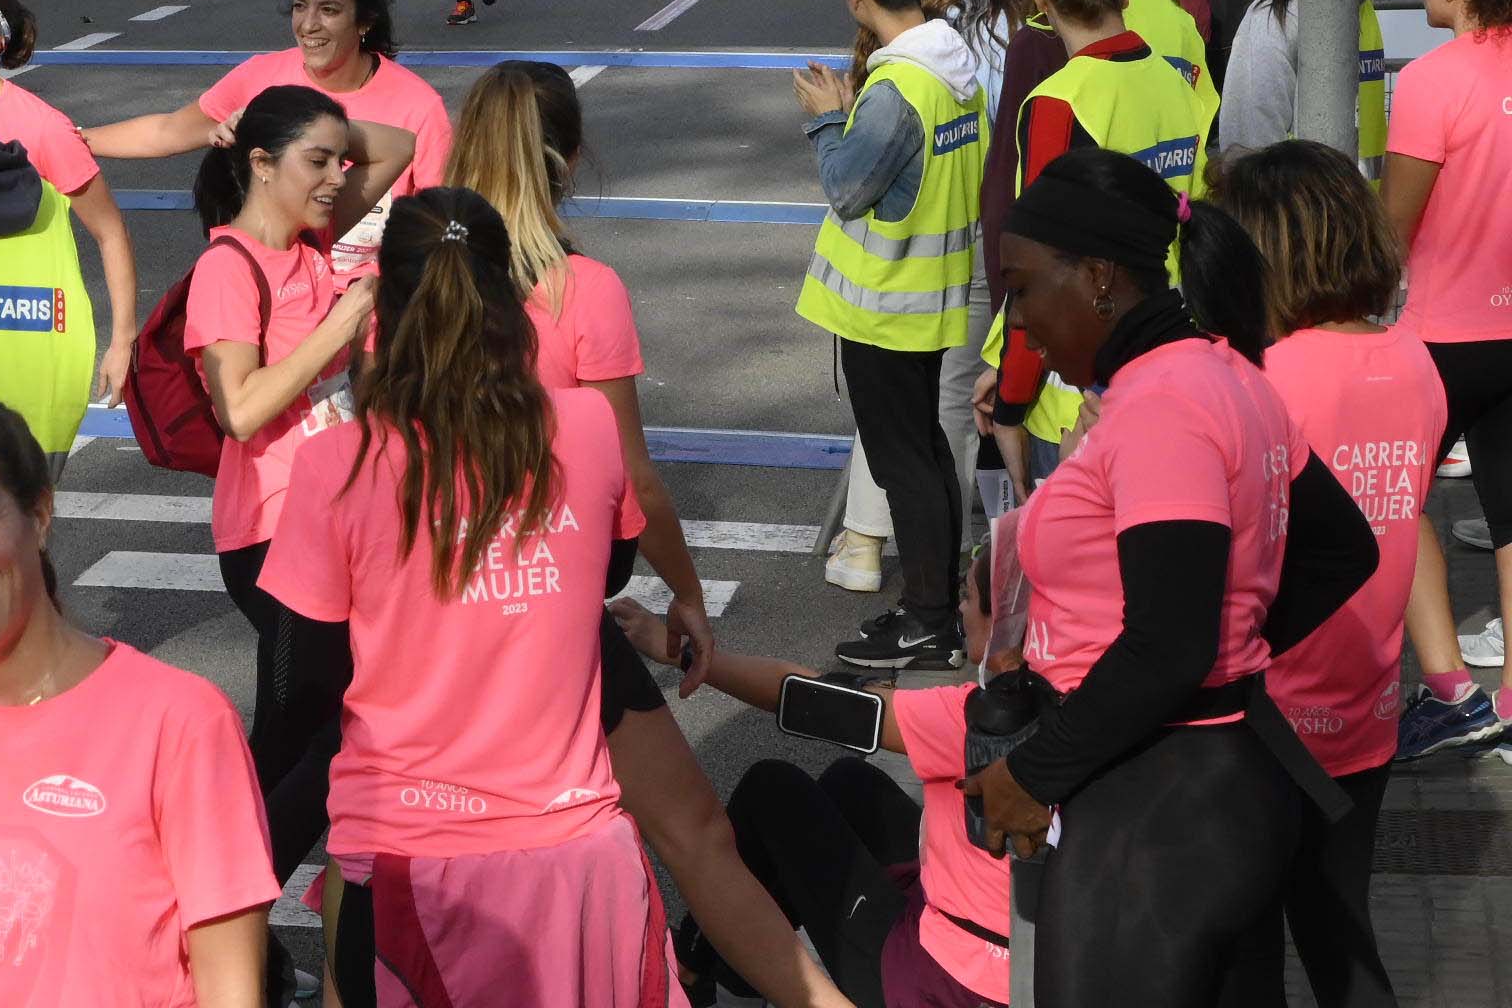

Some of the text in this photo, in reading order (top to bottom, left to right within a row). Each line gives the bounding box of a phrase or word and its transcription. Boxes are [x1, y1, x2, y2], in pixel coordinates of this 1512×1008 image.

[1352, 467, 1414, 497] DE LA
[517, 539, 555, 567] LA
[461, 567, 562, 605] MUJER
[503, 602, 528, 616] 2023
[1291, 717, 1343, 734] YSHO
[28, 788, 99, 813] ASTURIANA
[400, 787, 487, 815] OYSHO
